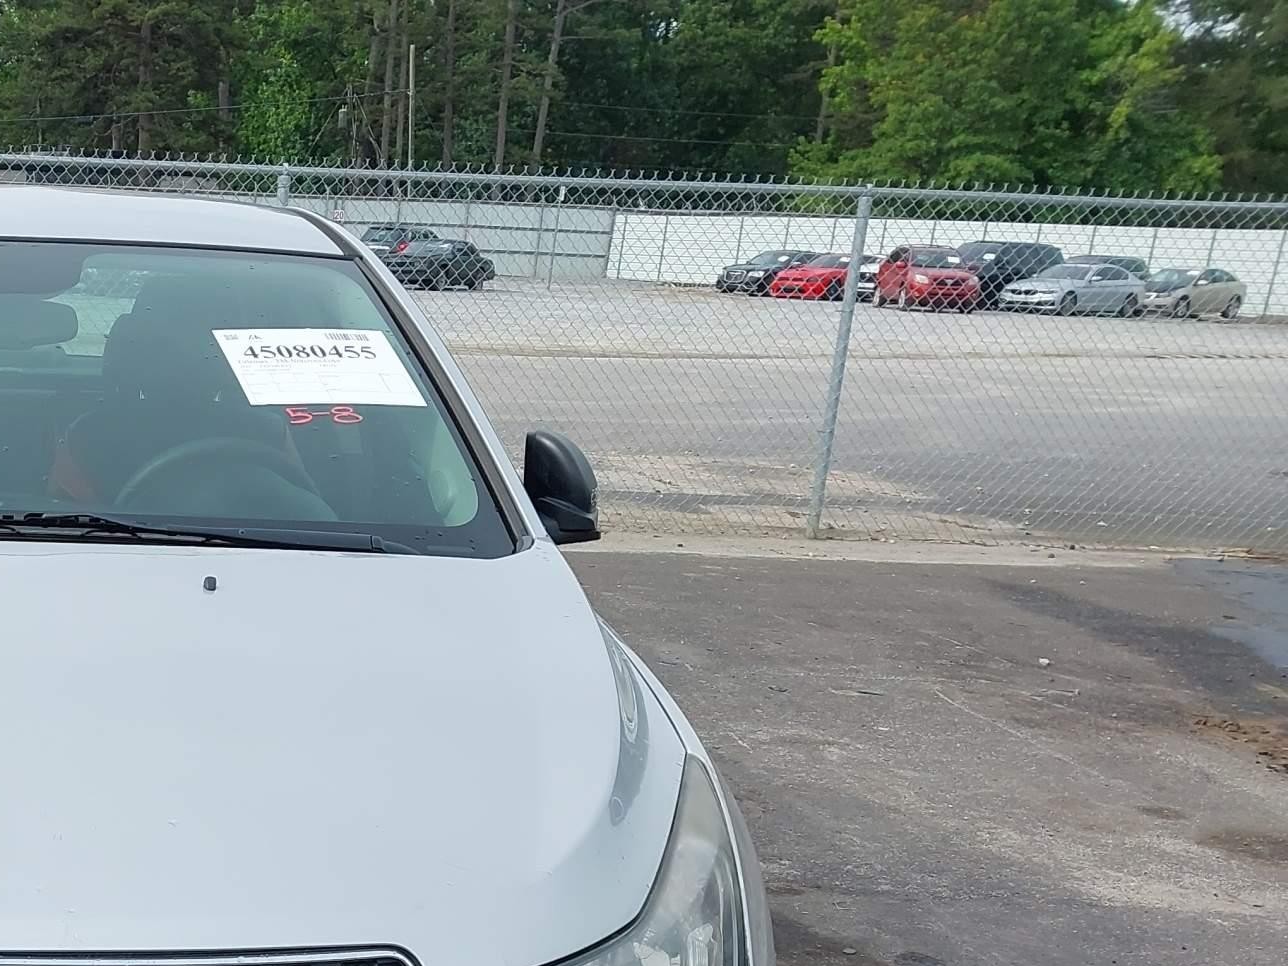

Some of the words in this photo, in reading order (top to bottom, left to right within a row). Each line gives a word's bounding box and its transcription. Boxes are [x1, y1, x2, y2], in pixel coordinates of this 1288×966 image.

[332, 211, 344, 220] 20
[243, 345, 377, 360] 45080455
[285, 406, 364, 424] 5-8
